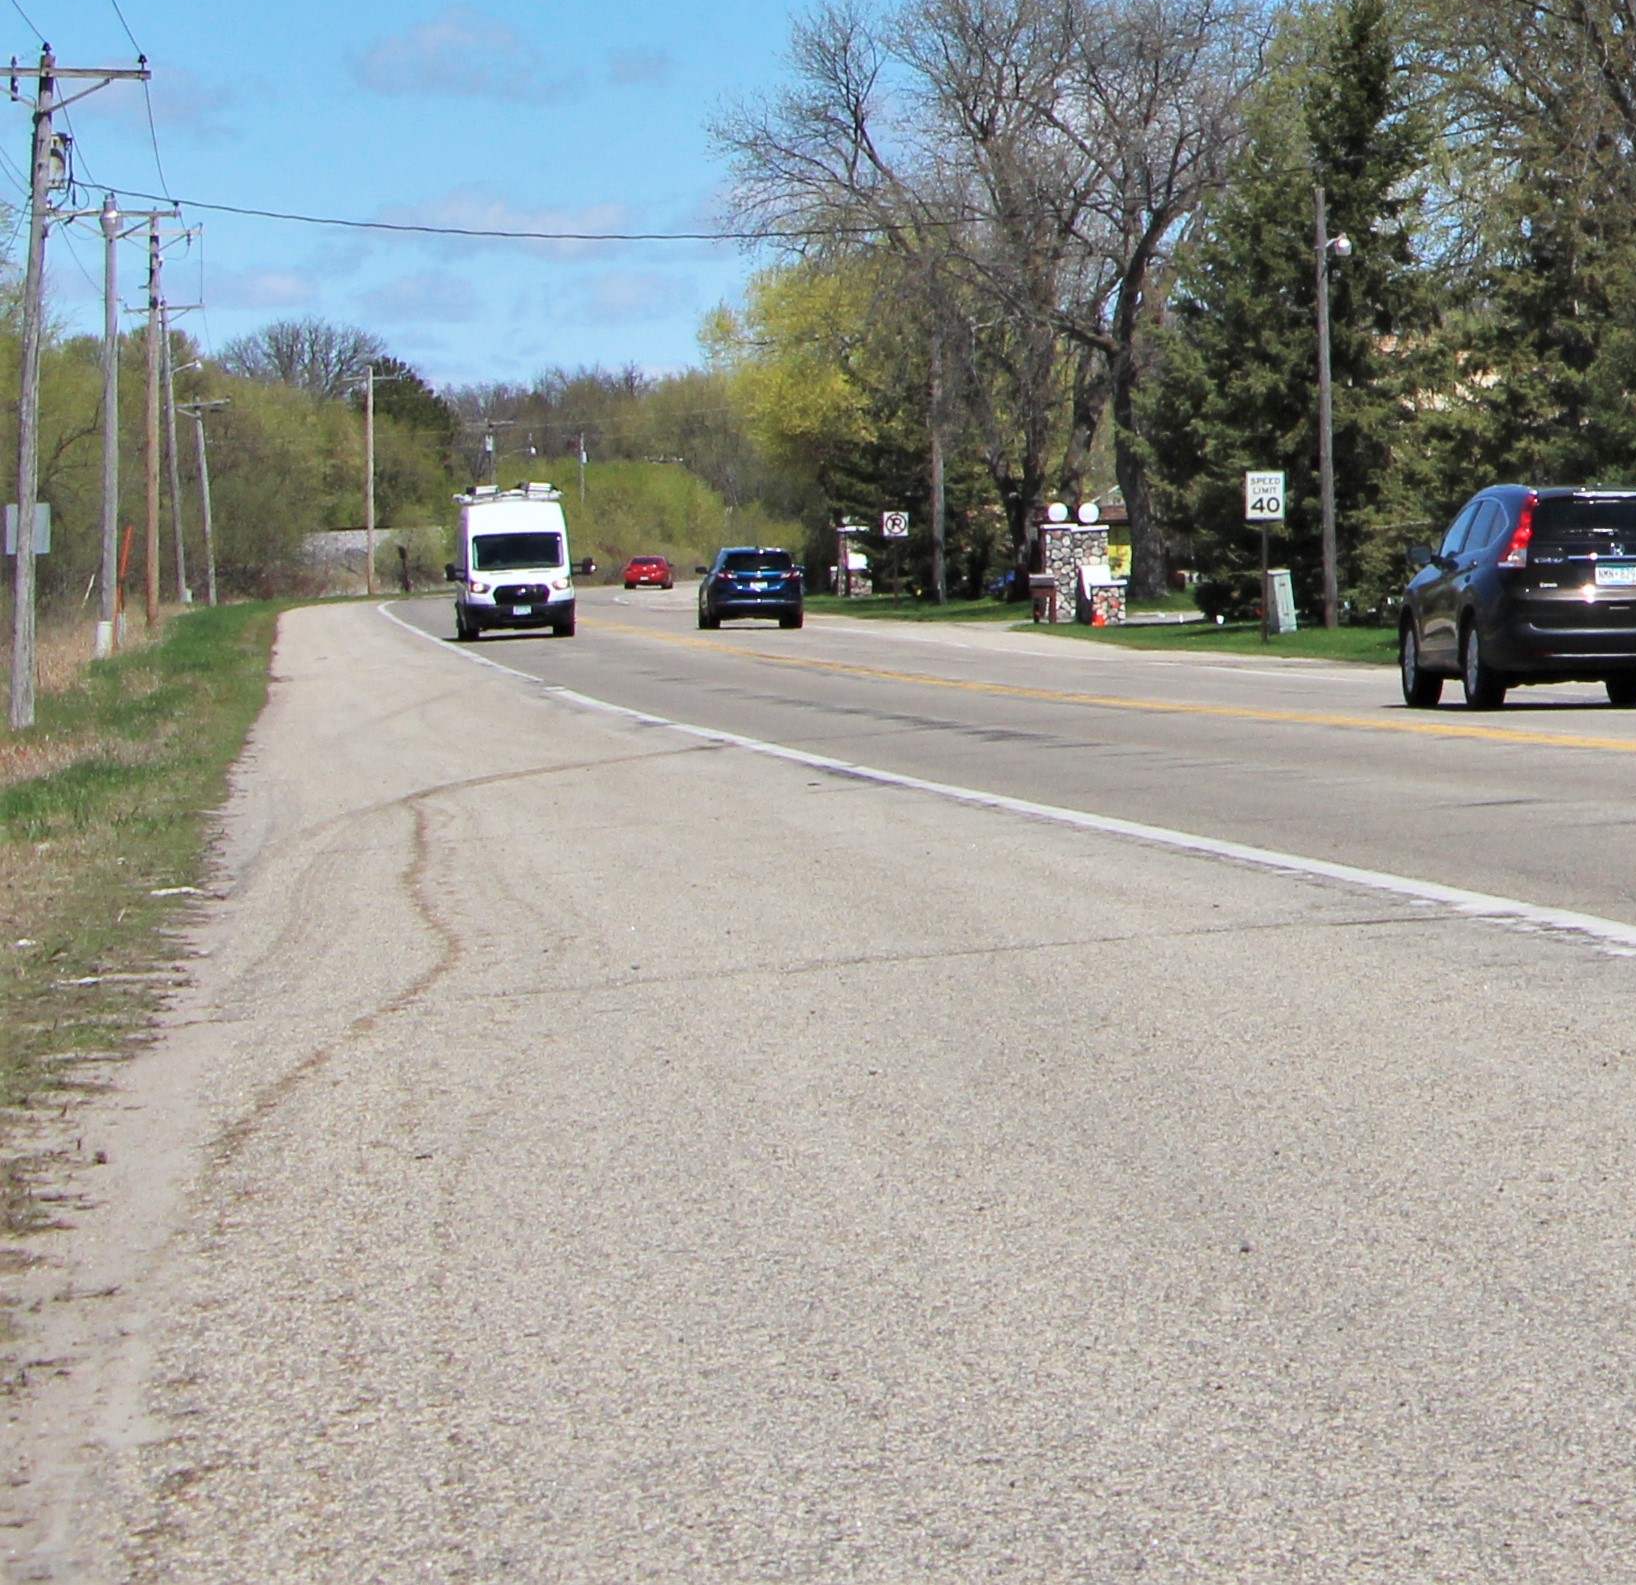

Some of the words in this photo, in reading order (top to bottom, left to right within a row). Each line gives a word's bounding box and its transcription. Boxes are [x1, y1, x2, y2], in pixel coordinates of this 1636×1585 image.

[1250, 477, 1280, 485] SPEED
[1253, 486, 1277, 494] LIMIT
[1251, 497, 1280, 513] 40
